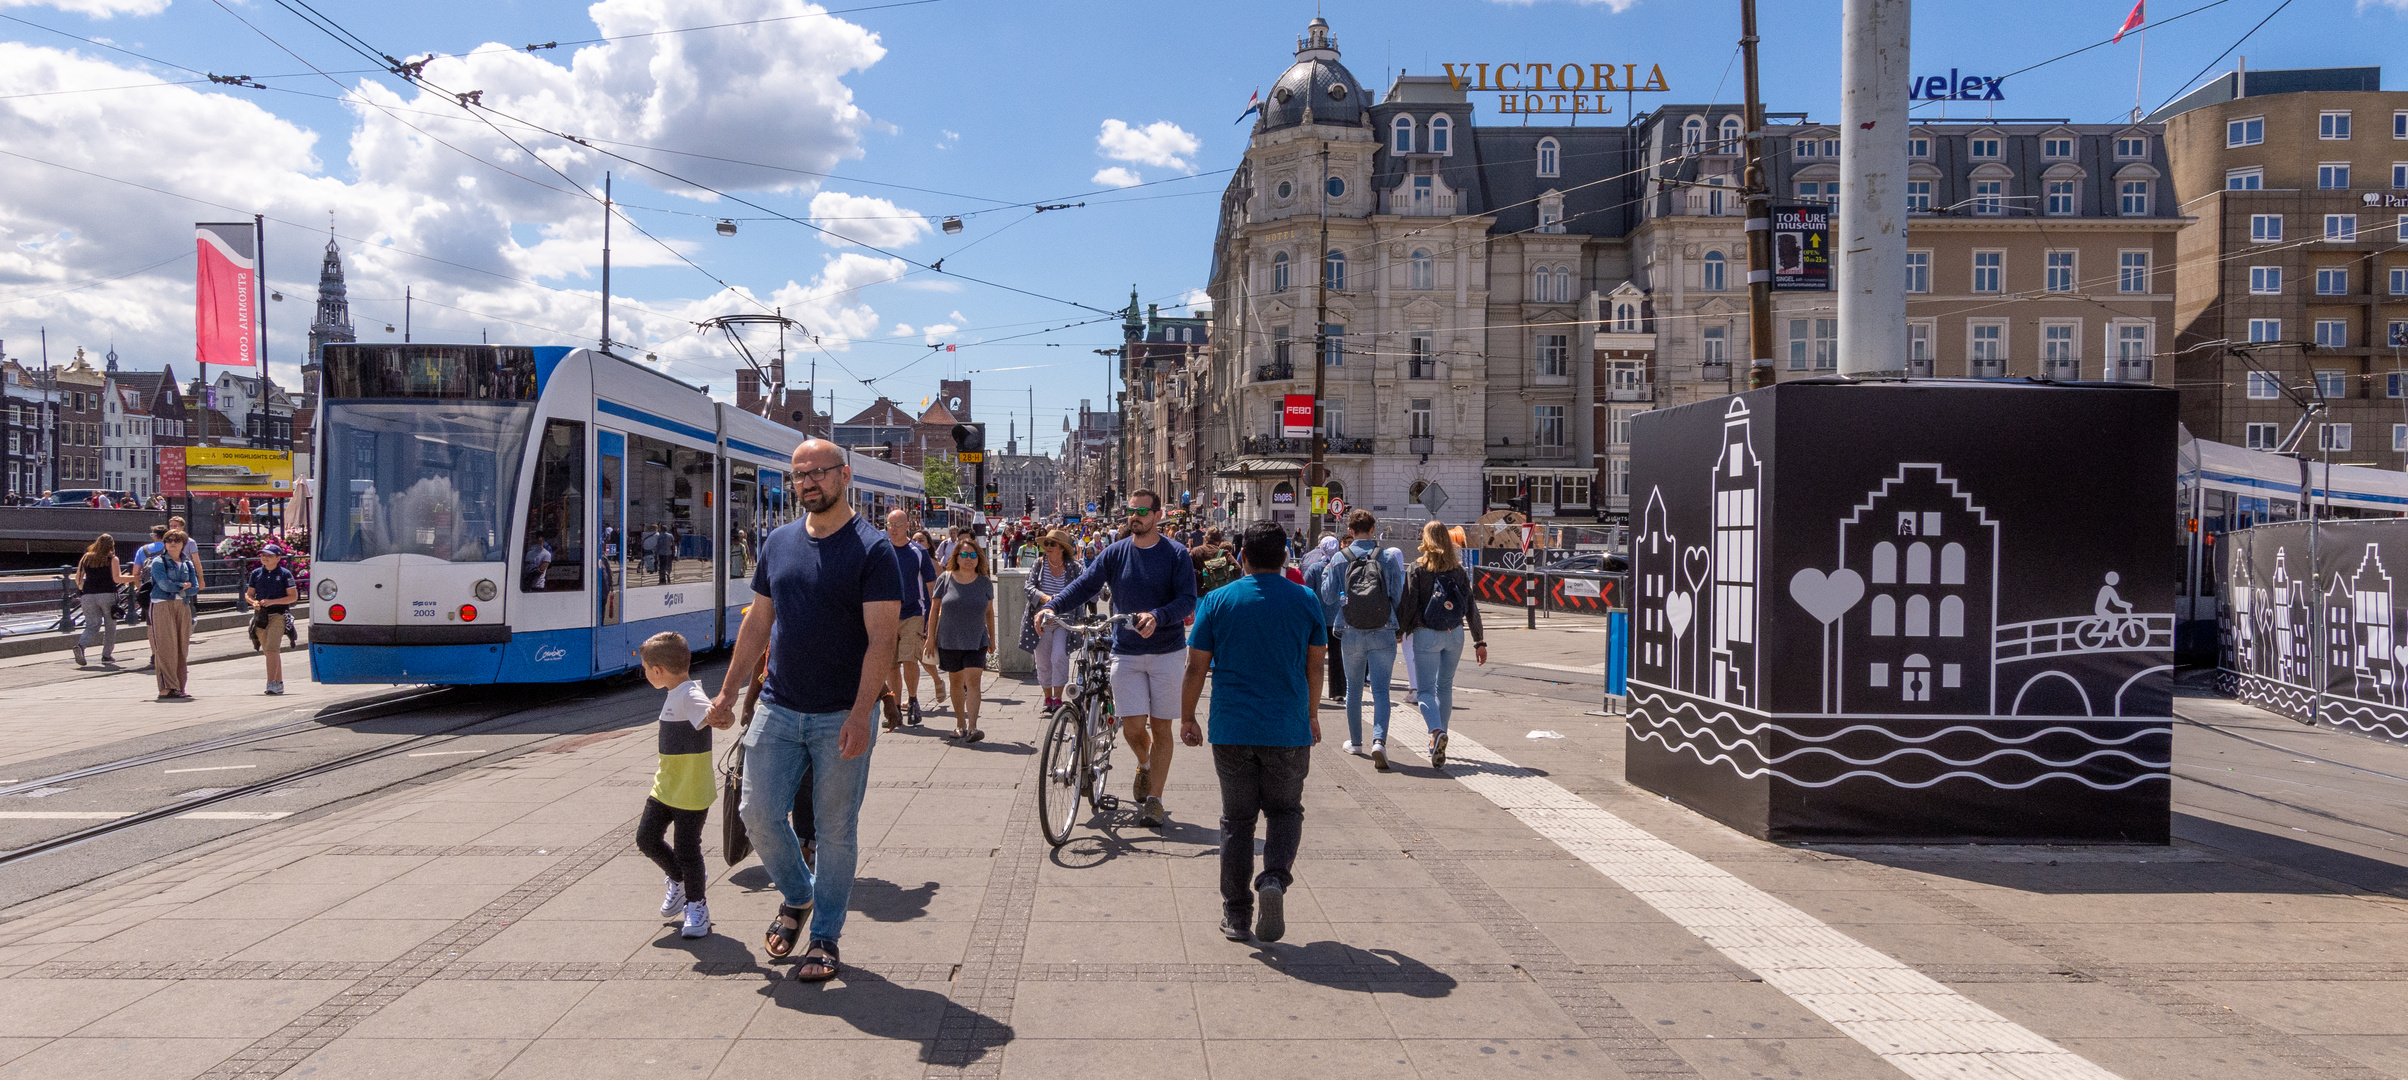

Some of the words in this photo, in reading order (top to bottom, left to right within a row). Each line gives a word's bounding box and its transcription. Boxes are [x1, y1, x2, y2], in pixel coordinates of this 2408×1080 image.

[1442, 63, 1670, 91] VICTORIA
[1909, 68, 2005, 100] velex
[1499, 94, 1613, 113] HOTEL
[1776, 209, 1827, 223] TORTURE
[1776, 222, 1827, 230] museum
[1265, 230, 1295, 243] HOTEL
[1286, 406, 1312, 415] FEBO
[1273, 492, 1293, 503] snipes
[413, 609, 436, 617] 2003
